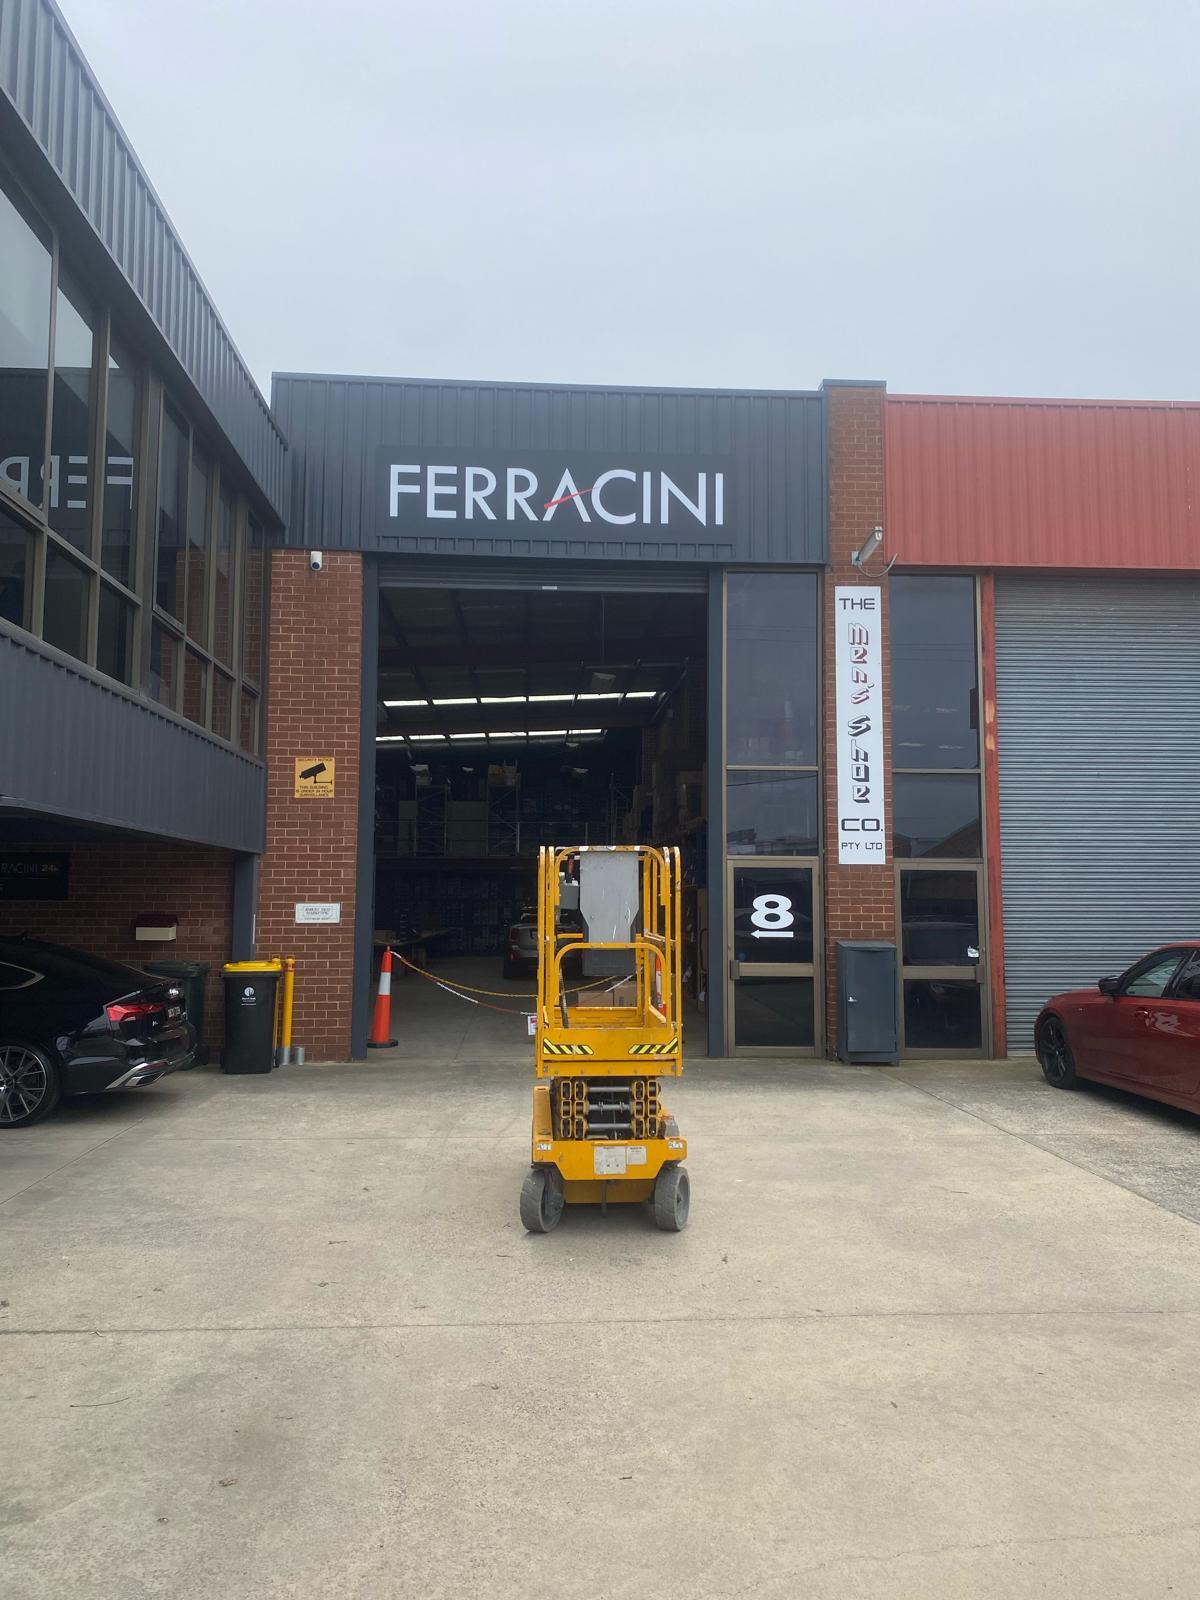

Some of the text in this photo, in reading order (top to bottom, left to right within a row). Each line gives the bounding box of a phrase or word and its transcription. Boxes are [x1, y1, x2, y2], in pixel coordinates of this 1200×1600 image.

[389, 464, 723, 526] FERRACINI
[839, 598, 875, 610] THE
[841, 842, 883, 850] PTY LTD
[750, 894, 795, 929] 8
